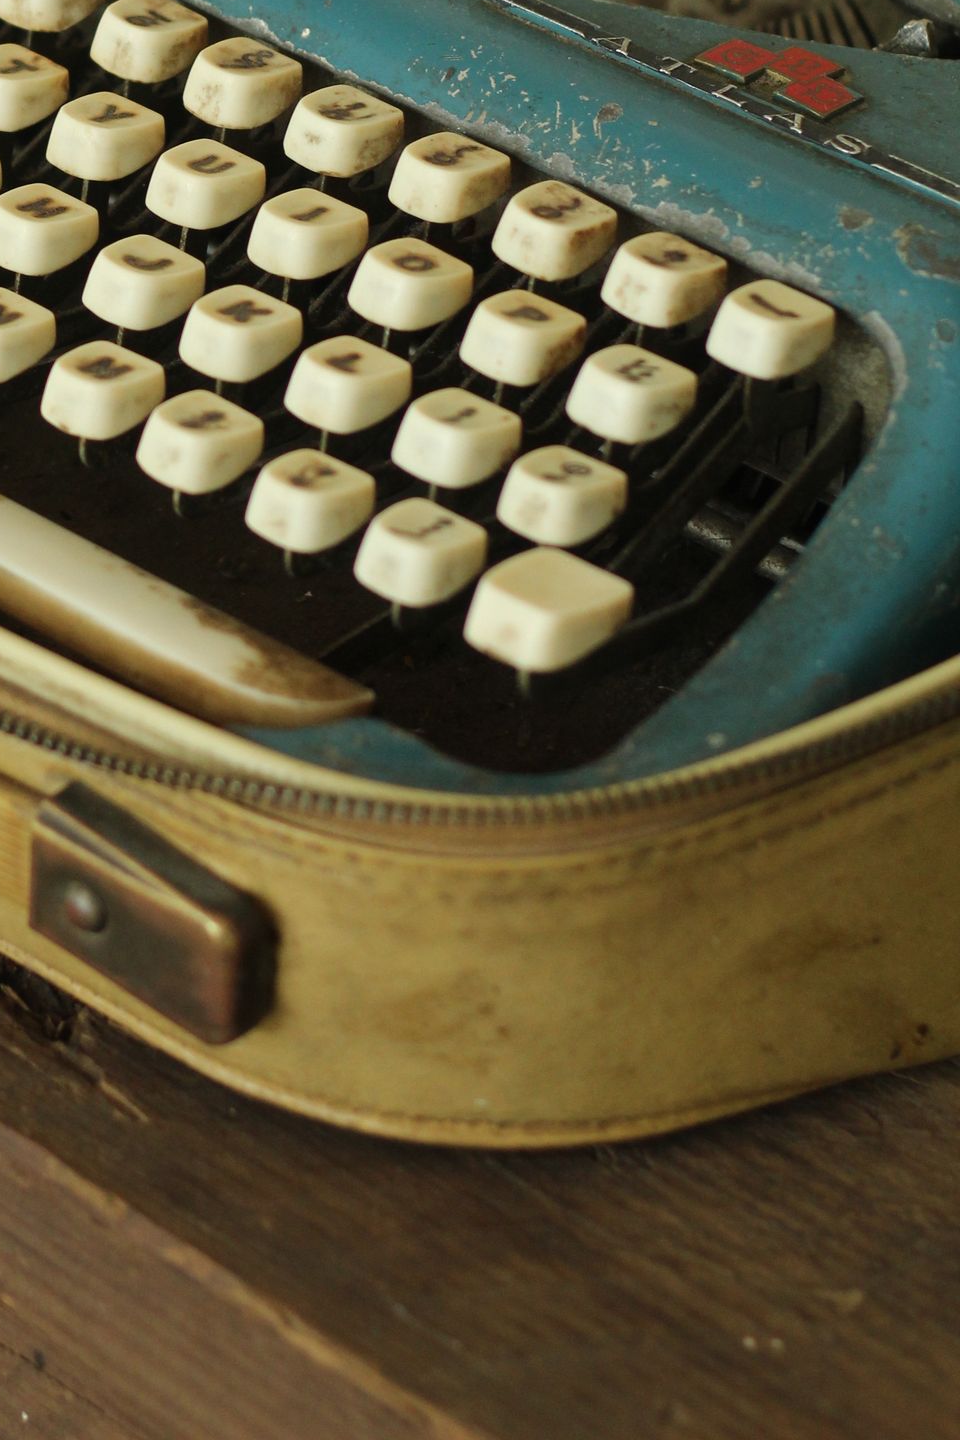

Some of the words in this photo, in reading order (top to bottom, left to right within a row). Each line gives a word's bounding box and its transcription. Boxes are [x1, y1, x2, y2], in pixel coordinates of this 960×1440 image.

[592, 35, 873, 155] ATLAS
[15, 196, 71, 219] H
[121, 253, 175, 271] J
[215, 299, 274, 323] K
[323, 352, 364, 374] L
[90, 104, 137, 123] Y
[187, 154, 237, 174] U
[391, 252, 439, 273] O
[501, 305, 551, 322] P
